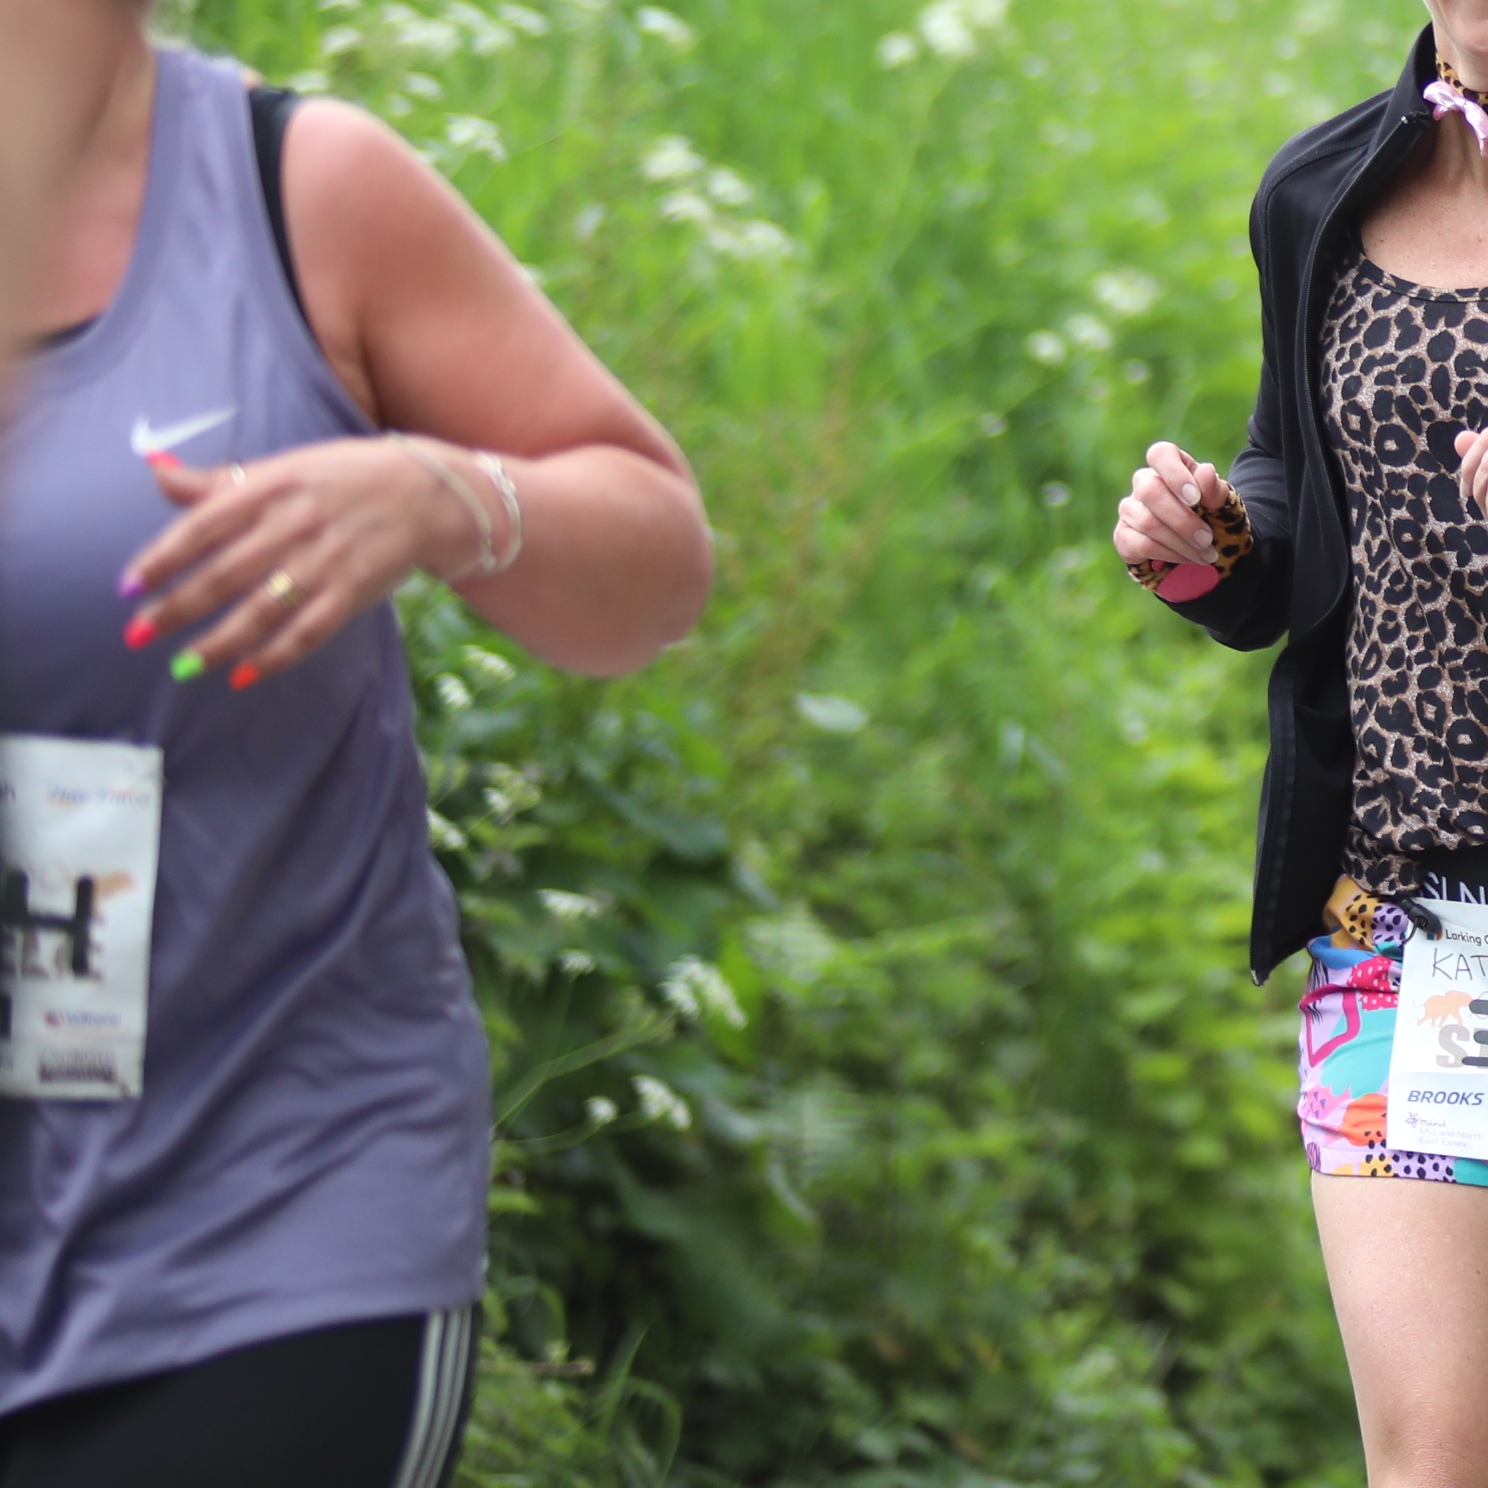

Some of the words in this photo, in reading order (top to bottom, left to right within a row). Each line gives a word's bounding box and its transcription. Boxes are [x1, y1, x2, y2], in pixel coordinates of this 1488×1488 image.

[1445, 929, 1482, 947] Larking
[1407, 1090, 1485, 1106] BROOKS
[1420, 1127, 1436, 1137] Mid
[1438, 1129, 1455, 1138] and
[1457, 1131, 1484, 1140] North
[1419, 1136, 1438, 1145] East
[1441, 1138, 1467, 1148] Essex
